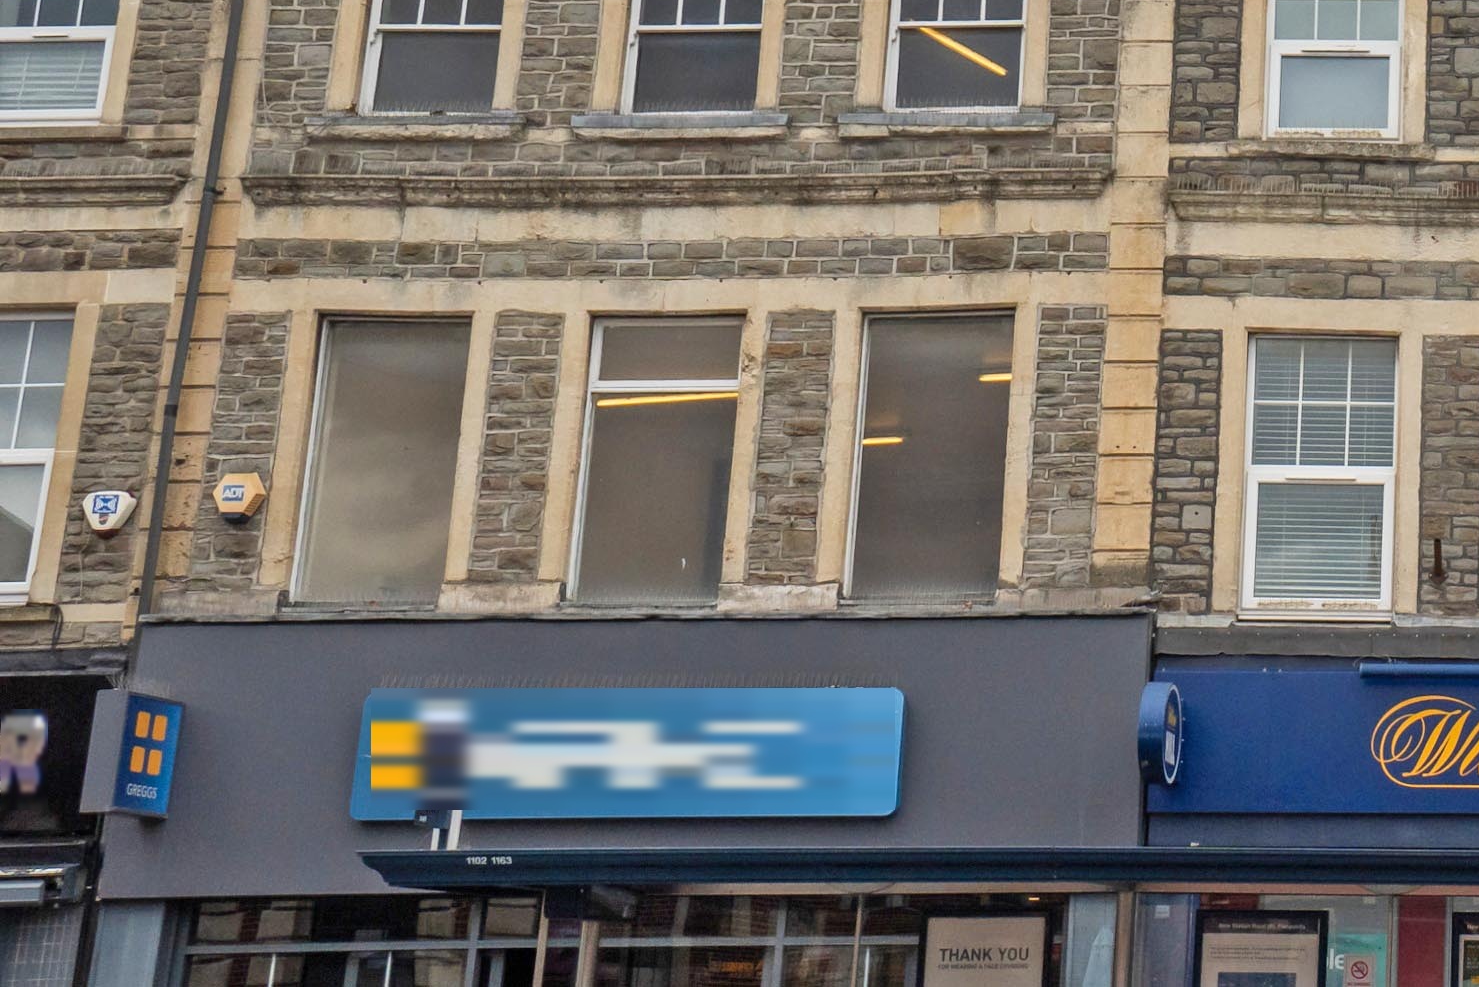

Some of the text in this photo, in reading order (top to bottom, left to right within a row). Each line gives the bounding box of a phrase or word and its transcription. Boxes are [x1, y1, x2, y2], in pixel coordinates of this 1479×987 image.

[223, 487, 243, 498] ADT
[126, 782, 157, 800] GREGGS
[466, 856, 512, 865] 1102 1163
[939, 947, 1030, 962] THANK YOU
